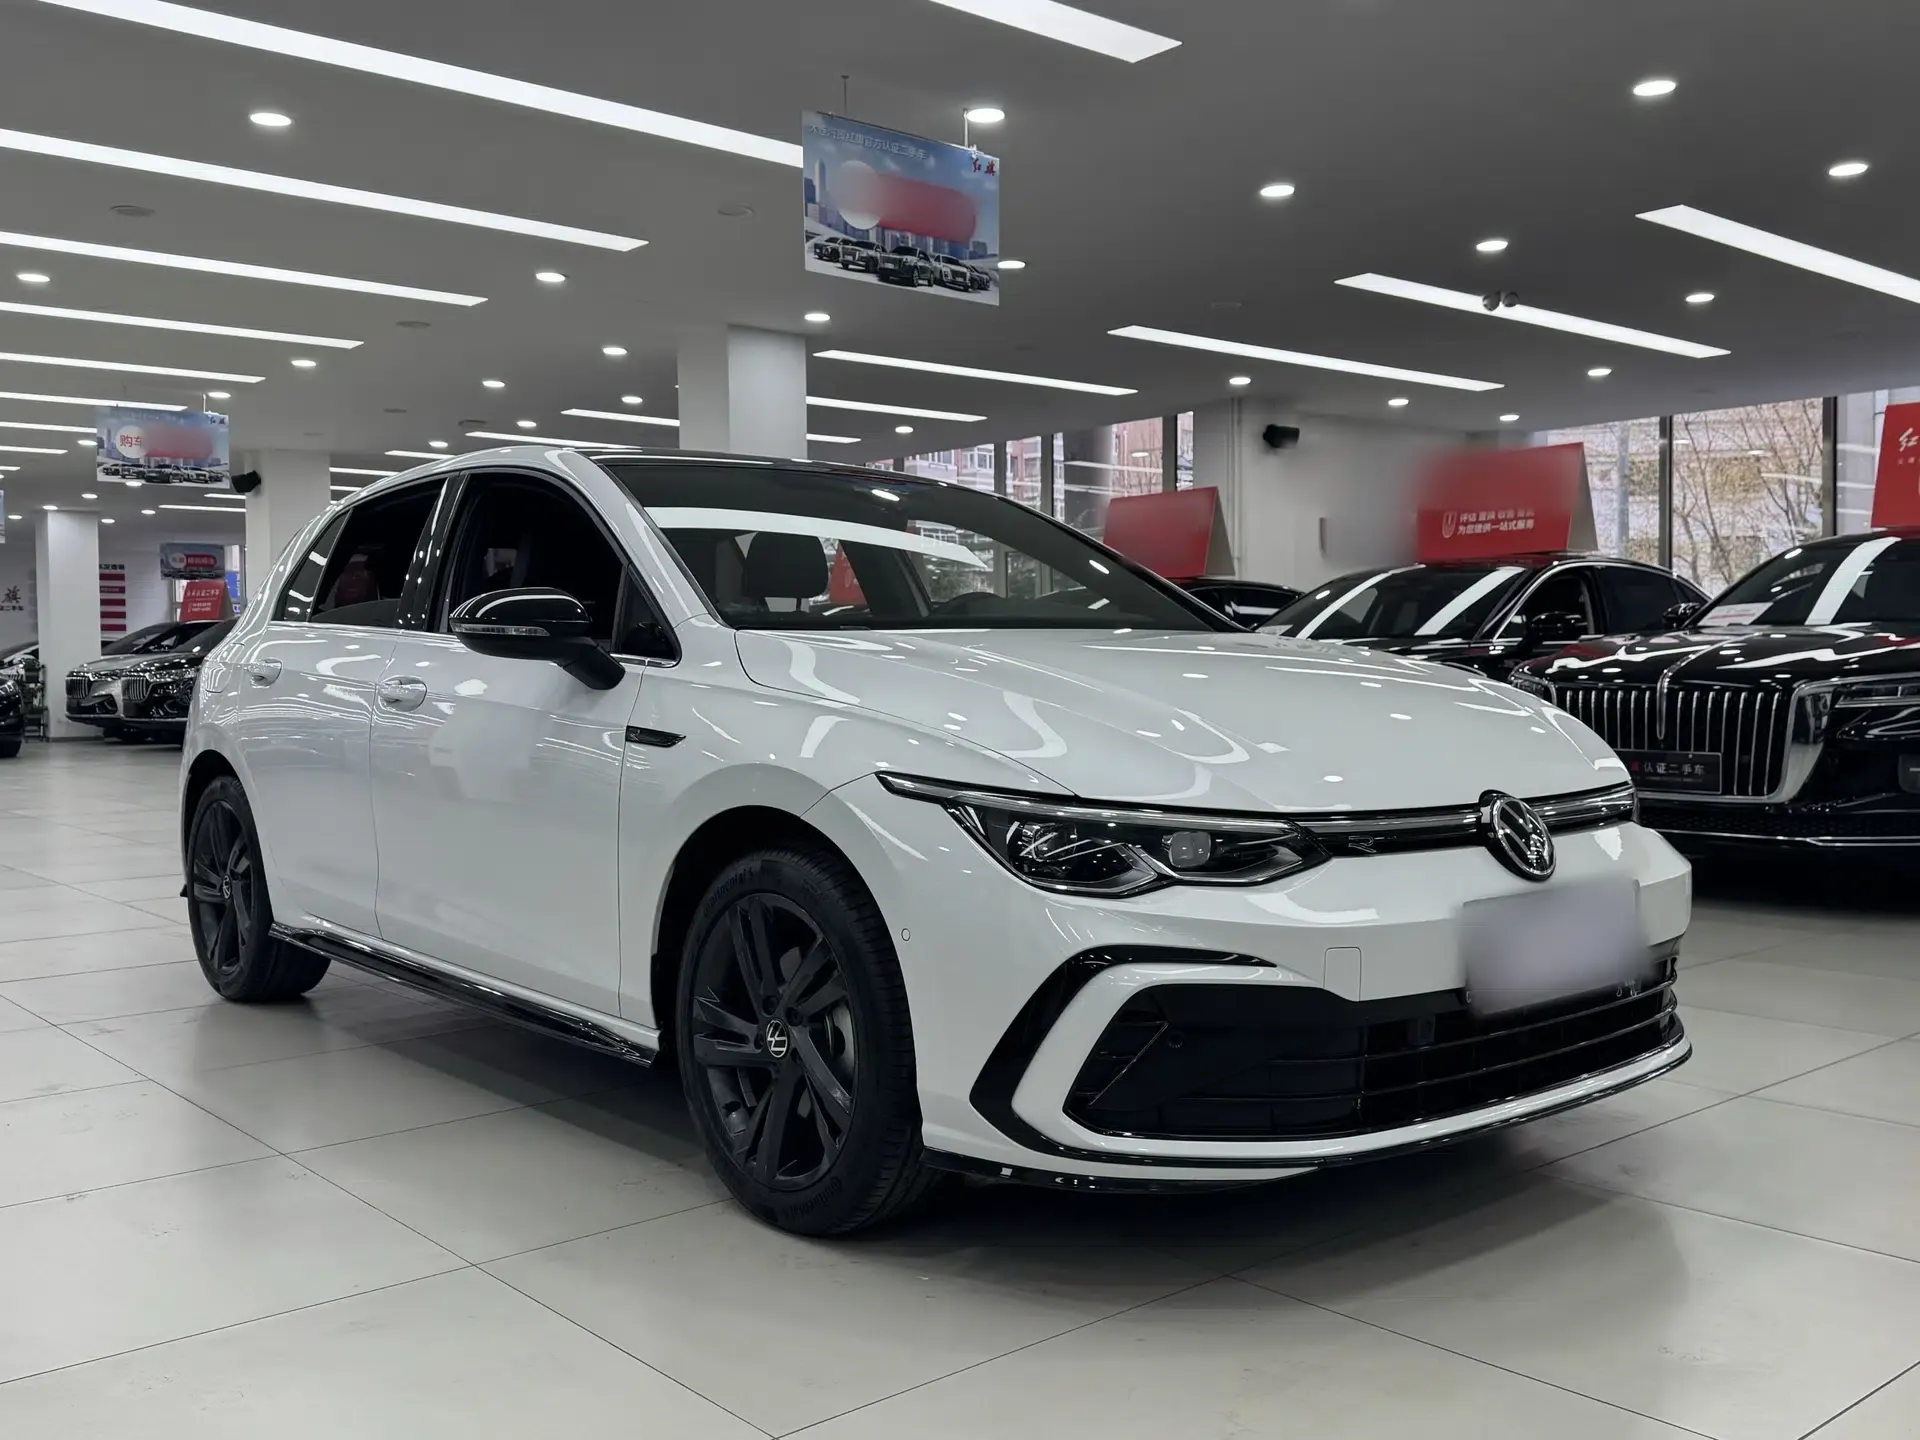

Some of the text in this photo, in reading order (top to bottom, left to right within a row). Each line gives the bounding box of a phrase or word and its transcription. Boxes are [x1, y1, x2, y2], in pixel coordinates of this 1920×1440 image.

[1457, 518, 1535, 535] 为您提供一站式服务
